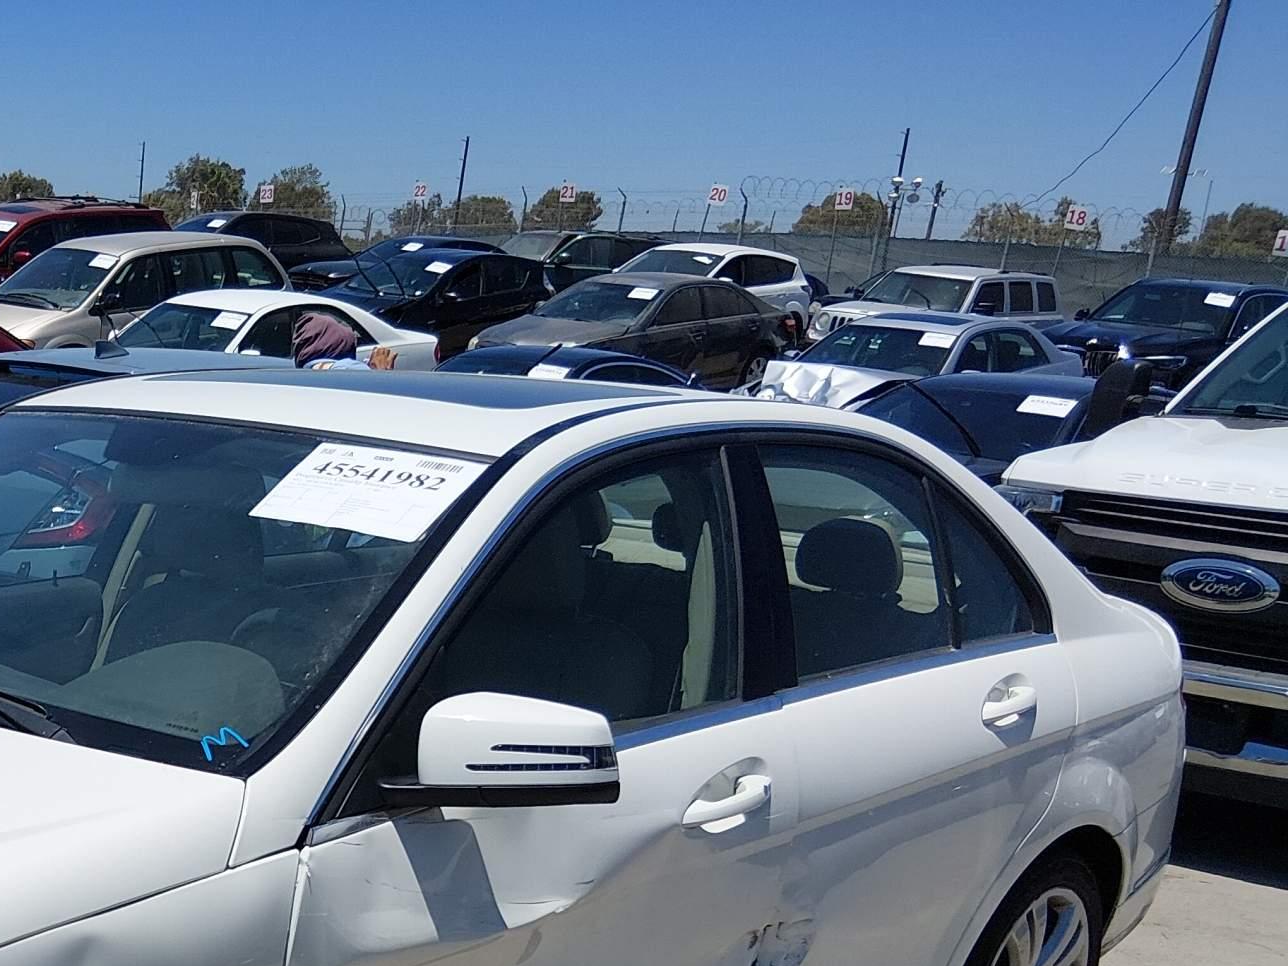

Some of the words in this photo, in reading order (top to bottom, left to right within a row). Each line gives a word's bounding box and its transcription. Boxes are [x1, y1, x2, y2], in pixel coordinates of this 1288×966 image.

[260, 188, 273, 200] 23
[414, 185, 427, 197] 22
[561, 185, 575, 199] 21
[709, 187, 727, 202] 20
[836, 191, 853, 206] 19
[1066, 209, 1087, 226] 18
[1274, 235, 1288, 252] 1
[312, 459, 447, 492] 45541982
[1188, 569, 1246, 598] Ford
